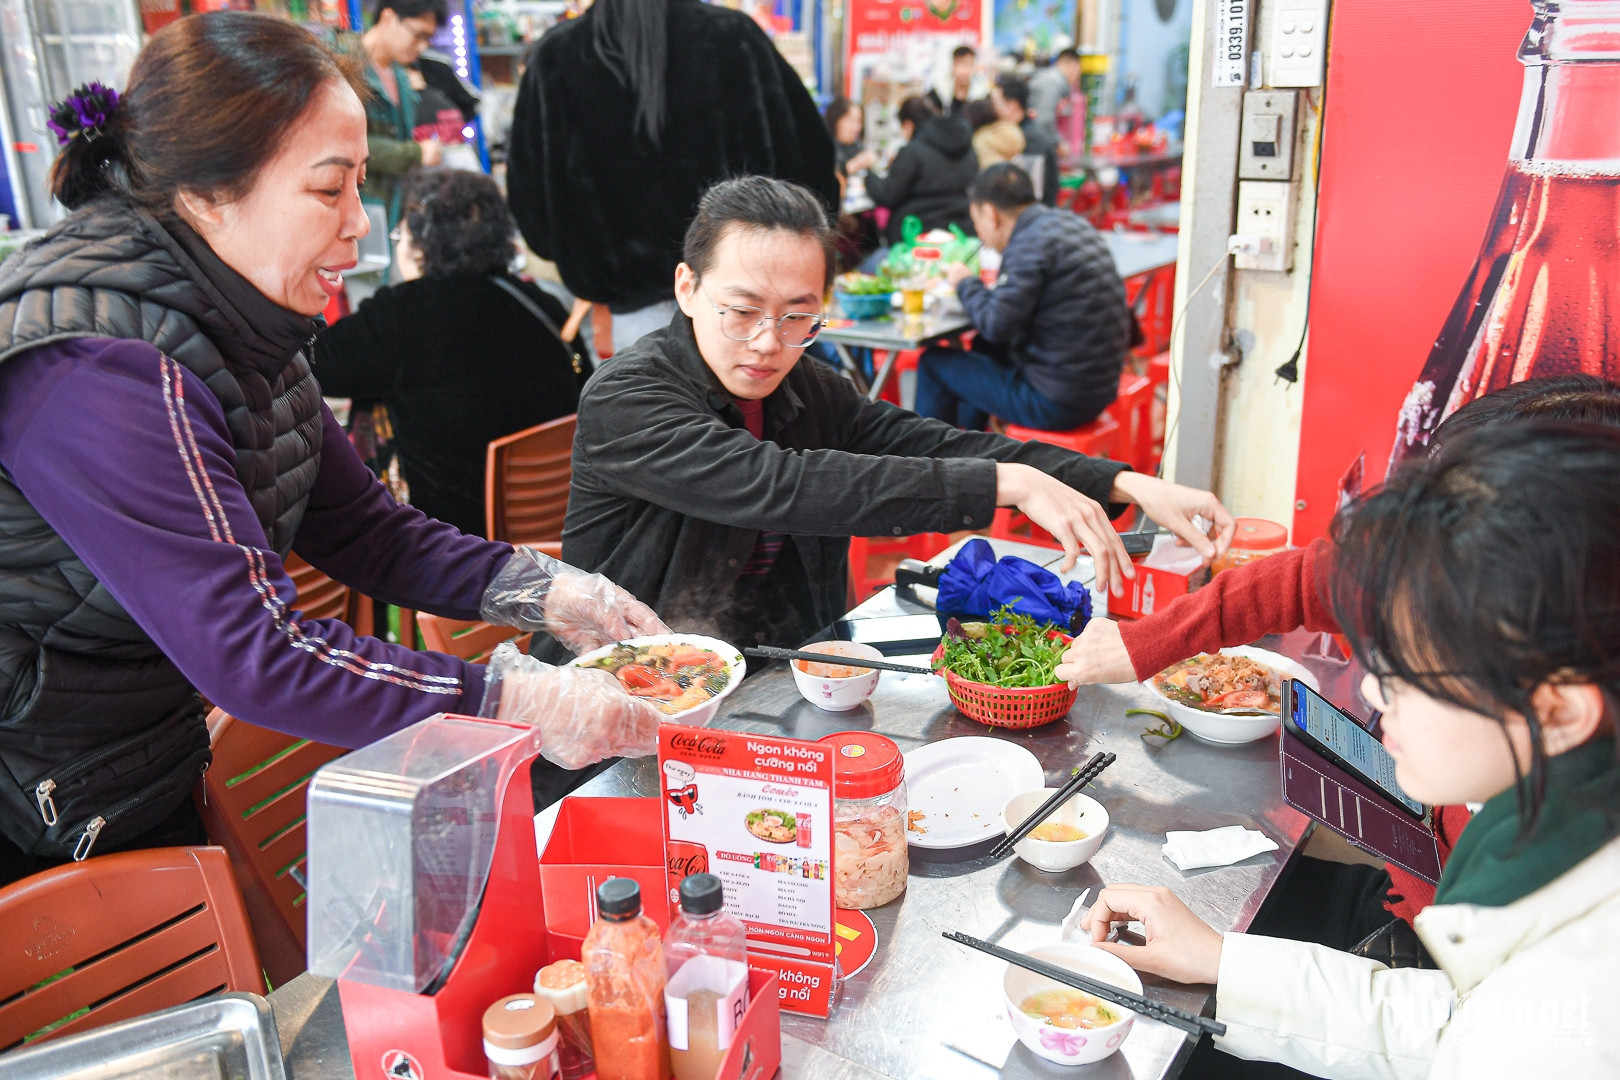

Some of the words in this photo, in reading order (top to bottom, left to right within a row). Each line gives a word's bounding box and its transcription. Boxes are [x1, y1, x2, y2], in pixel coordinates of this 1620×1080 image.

[747, 741, 781, 755] Ngon
[783, 745, 825, 762] không
[754, 756, 795, 772] cưỡng
[797, 760, 817, 773] nổi
[761, 784, 799, 797] Combo
[765, 929, 785, 937] NGON
[805, 935, 826, 944] NGON
[778, 968, 820, 988] không
[790, 986, 811, 1001] nổi
